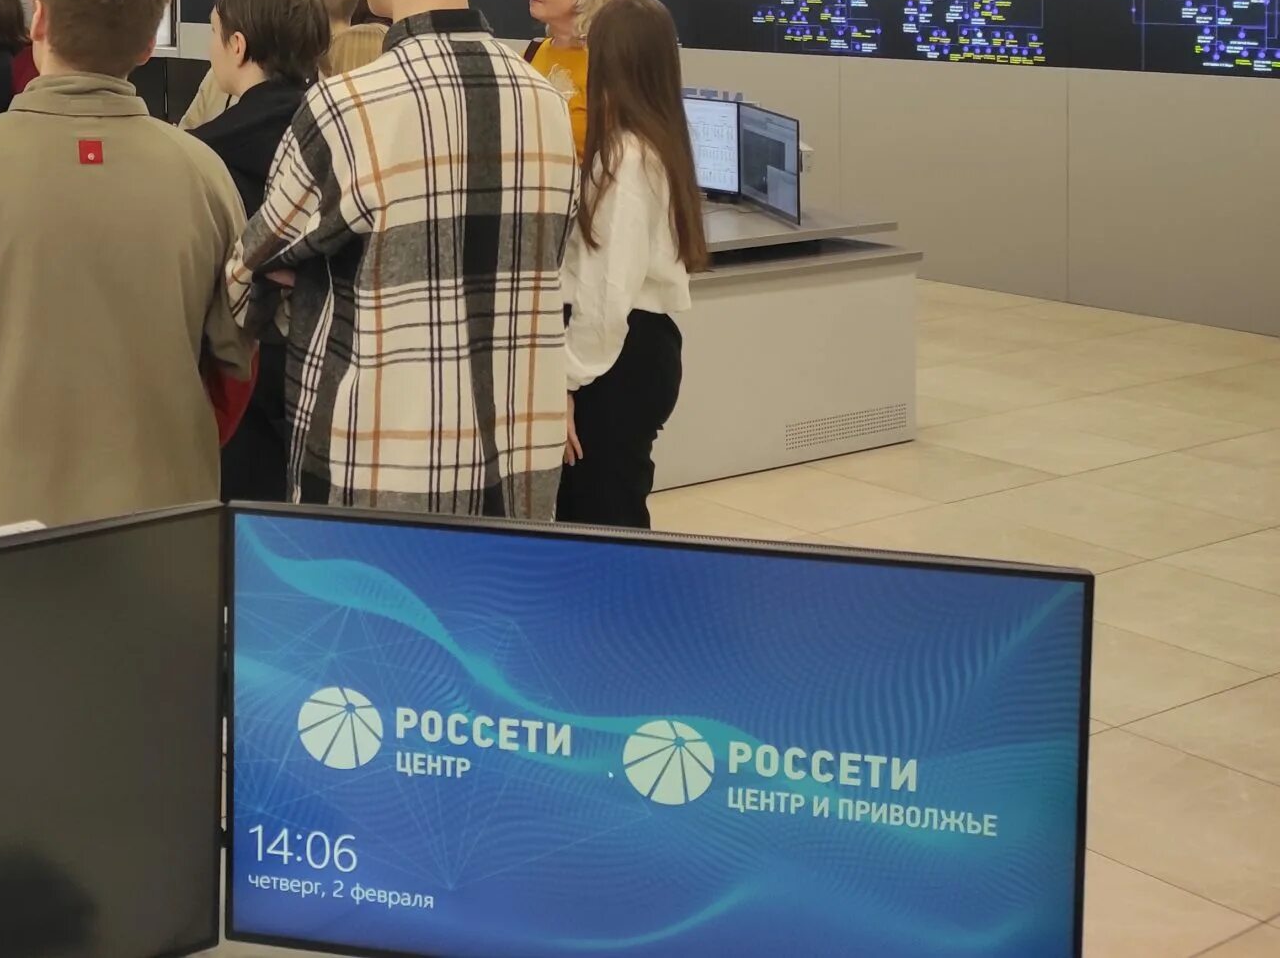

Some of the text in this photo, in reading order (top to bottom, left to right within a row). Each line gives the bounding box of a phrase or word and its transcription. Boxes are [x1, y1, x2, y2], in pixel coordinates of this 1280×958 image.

[396, 707, 571, 756] РОССЕТИ
[396, 751, 471, 778] ЦЕНТР
[728, 741, 918, 792] РОССЕТИ
[728, 787, 999, 837] ЦЕНТР И ПРИВОЛЖЬЕ
[248, 824, 358, 873] 14:06
[248, 874, 434, 909] четверг, 2 февраля
